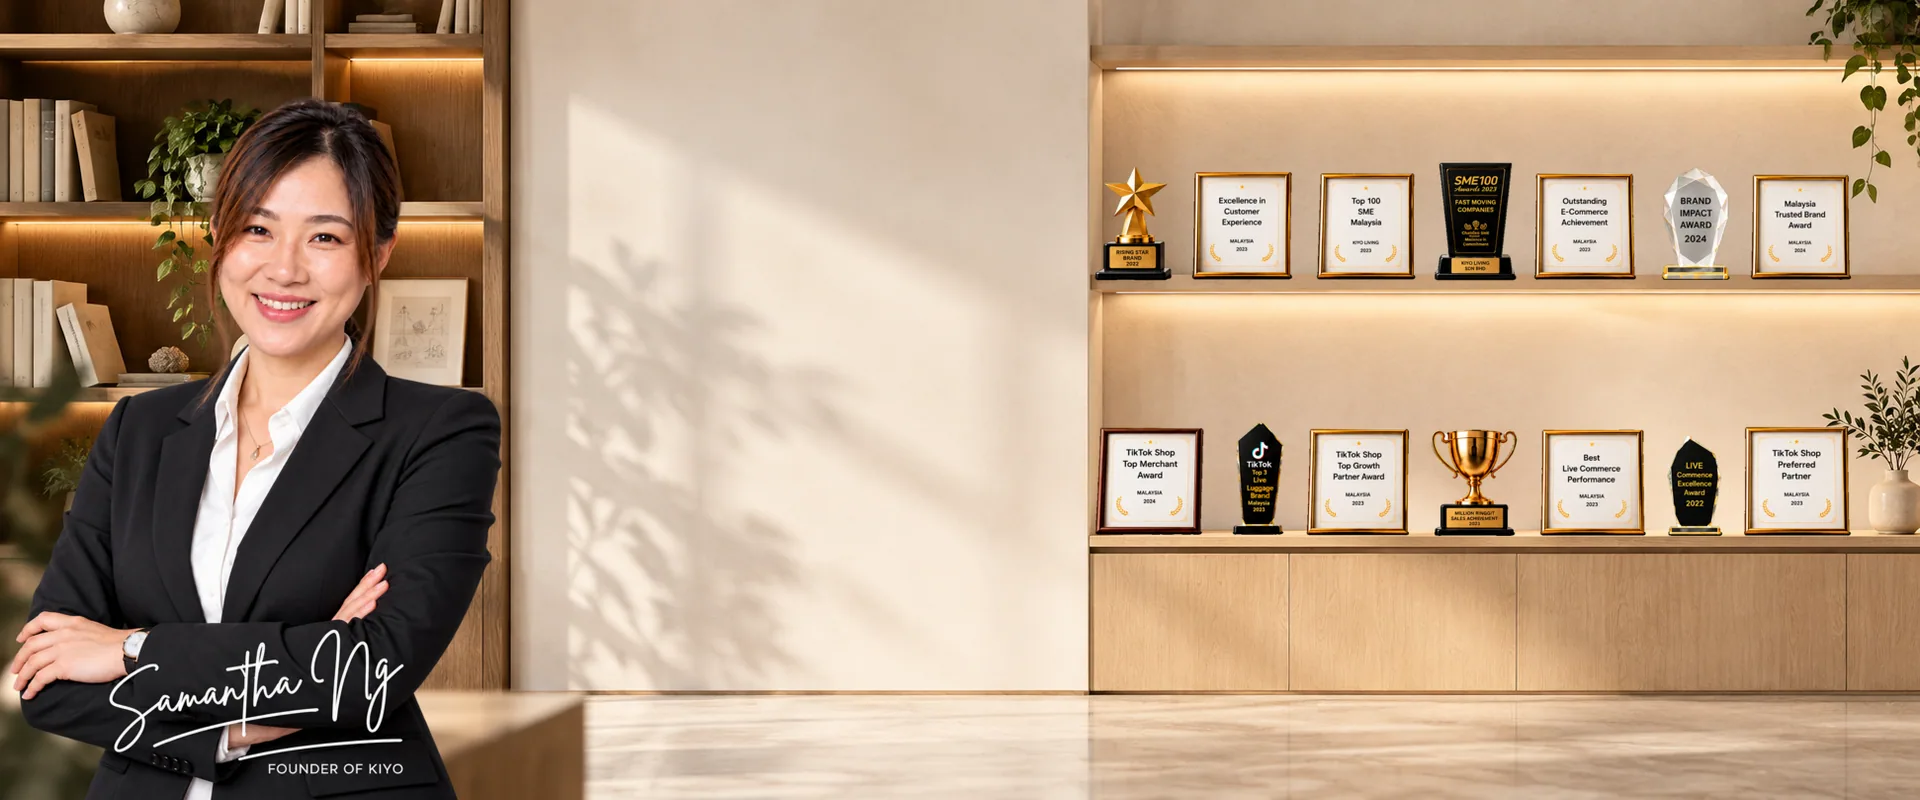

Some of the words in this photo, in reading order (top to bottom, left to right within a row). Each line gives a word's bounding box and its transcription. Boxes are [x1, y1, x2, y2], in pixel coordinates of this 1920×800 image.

[1352, 198, 1365, 206] Top
[1563, 198, 1607, 206] Outstanding
[1785, 201, 1816, 209] Malaysia
[1222, 219, 1262, 227] Experience
[1351, 219, 1382, 227] Malaysia
[1685, 235, 1706, 243] 2024
[1155, 449, 1175, 457] Shop
[1363, 451, 1382, 459] Shop
[1801, 450, 1821, 458] Shop
[1123, 461, 1137, 469] Top
[1338, 462, 1351, 470] Top
[1247, 485, 1274, 493] Luggage
